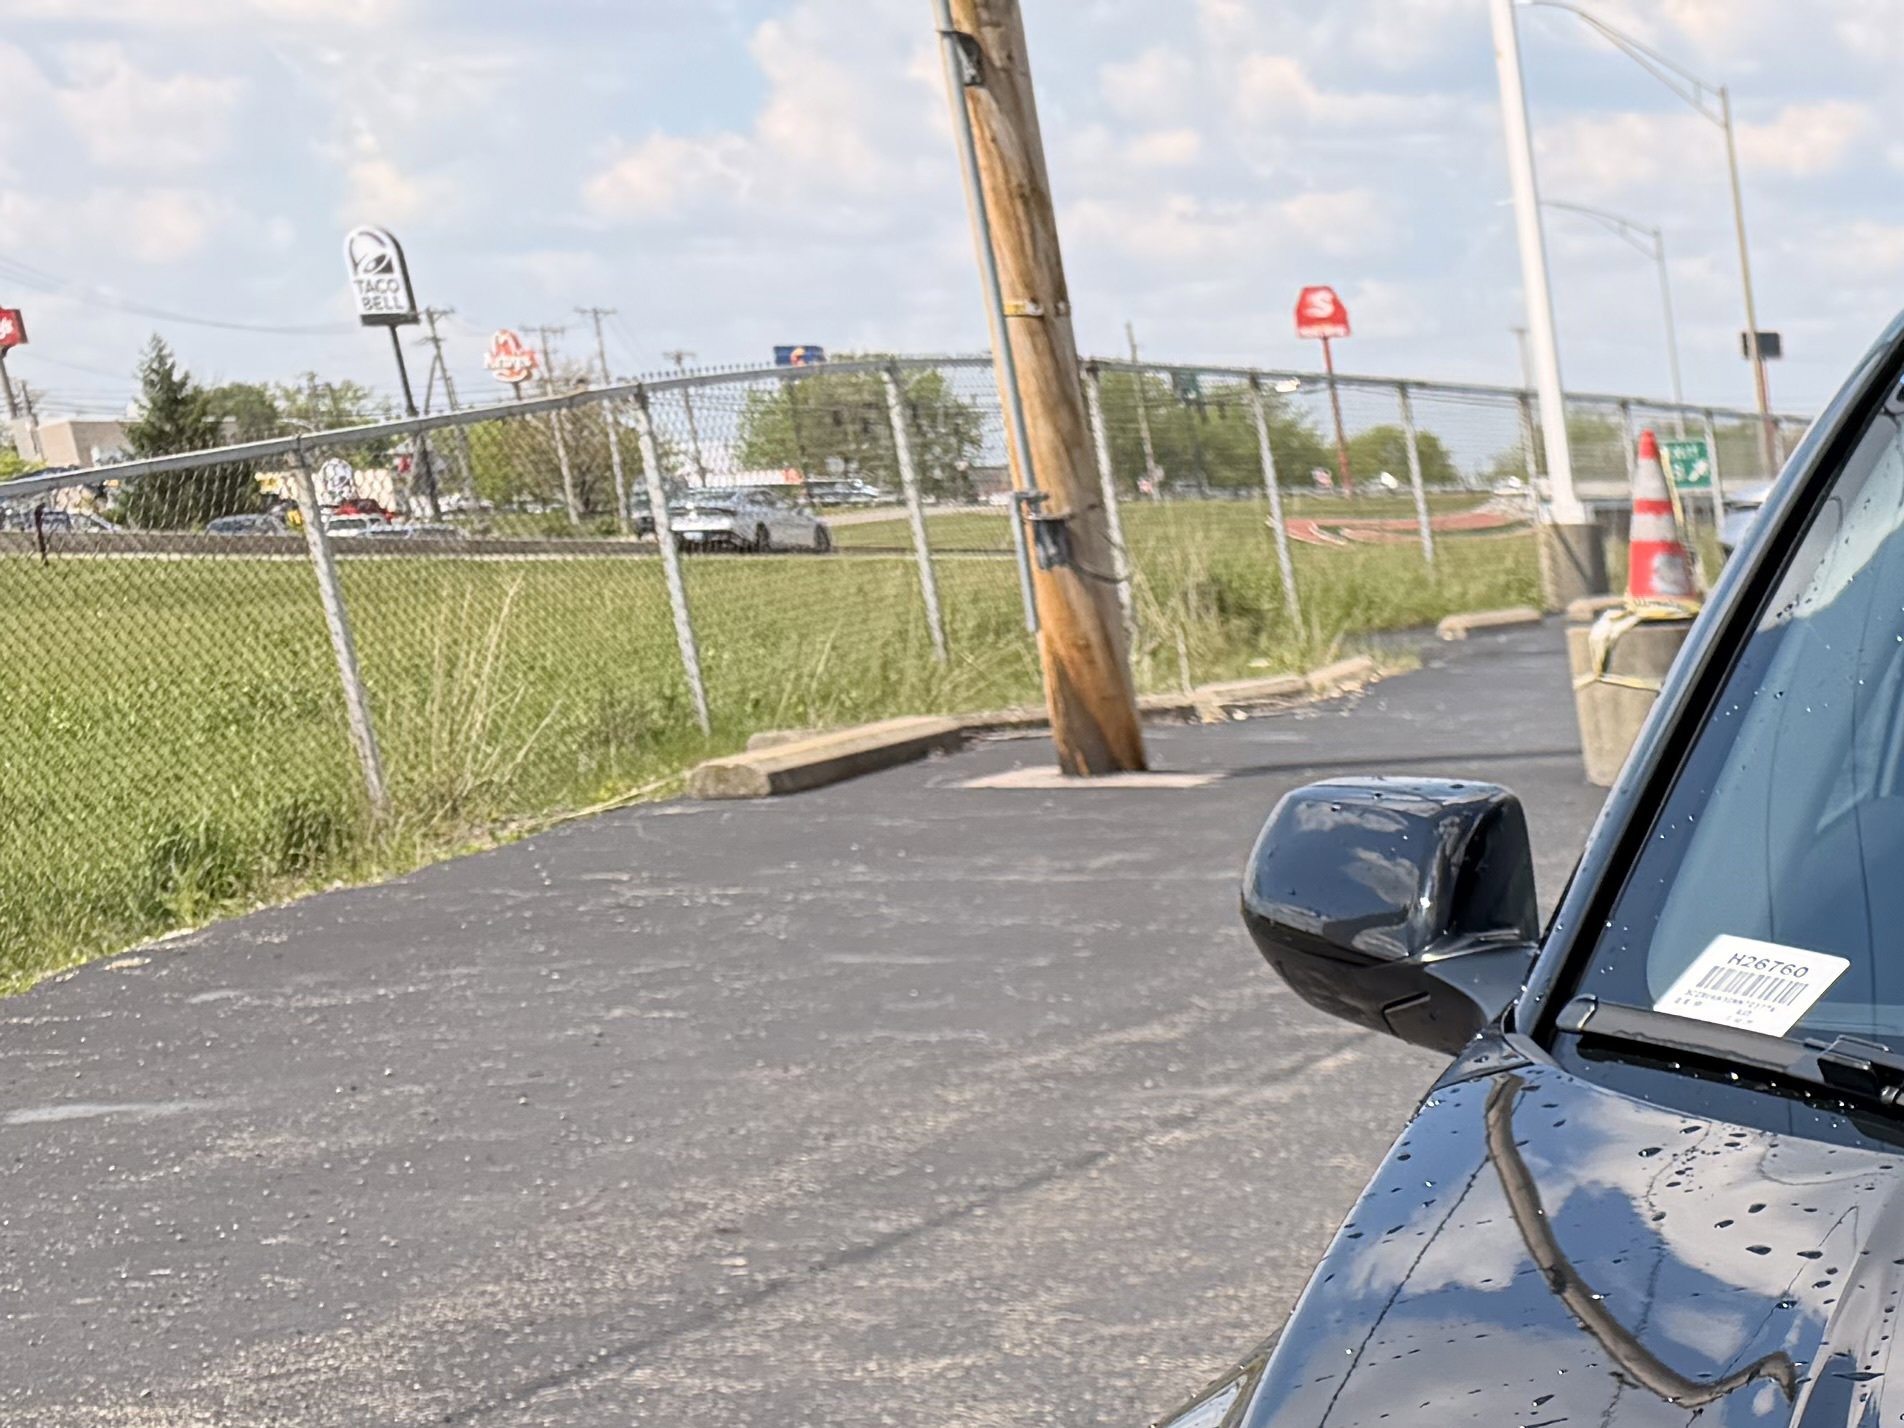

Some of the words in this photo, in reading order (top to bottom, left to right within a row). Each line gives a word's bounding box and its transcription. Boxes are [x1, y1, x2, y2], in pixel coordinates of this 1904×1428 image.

[353, 278, 400, 293] TACO
[361, 295, 404, 311] BELL
[1727, 952, 1809, 978] H26760
